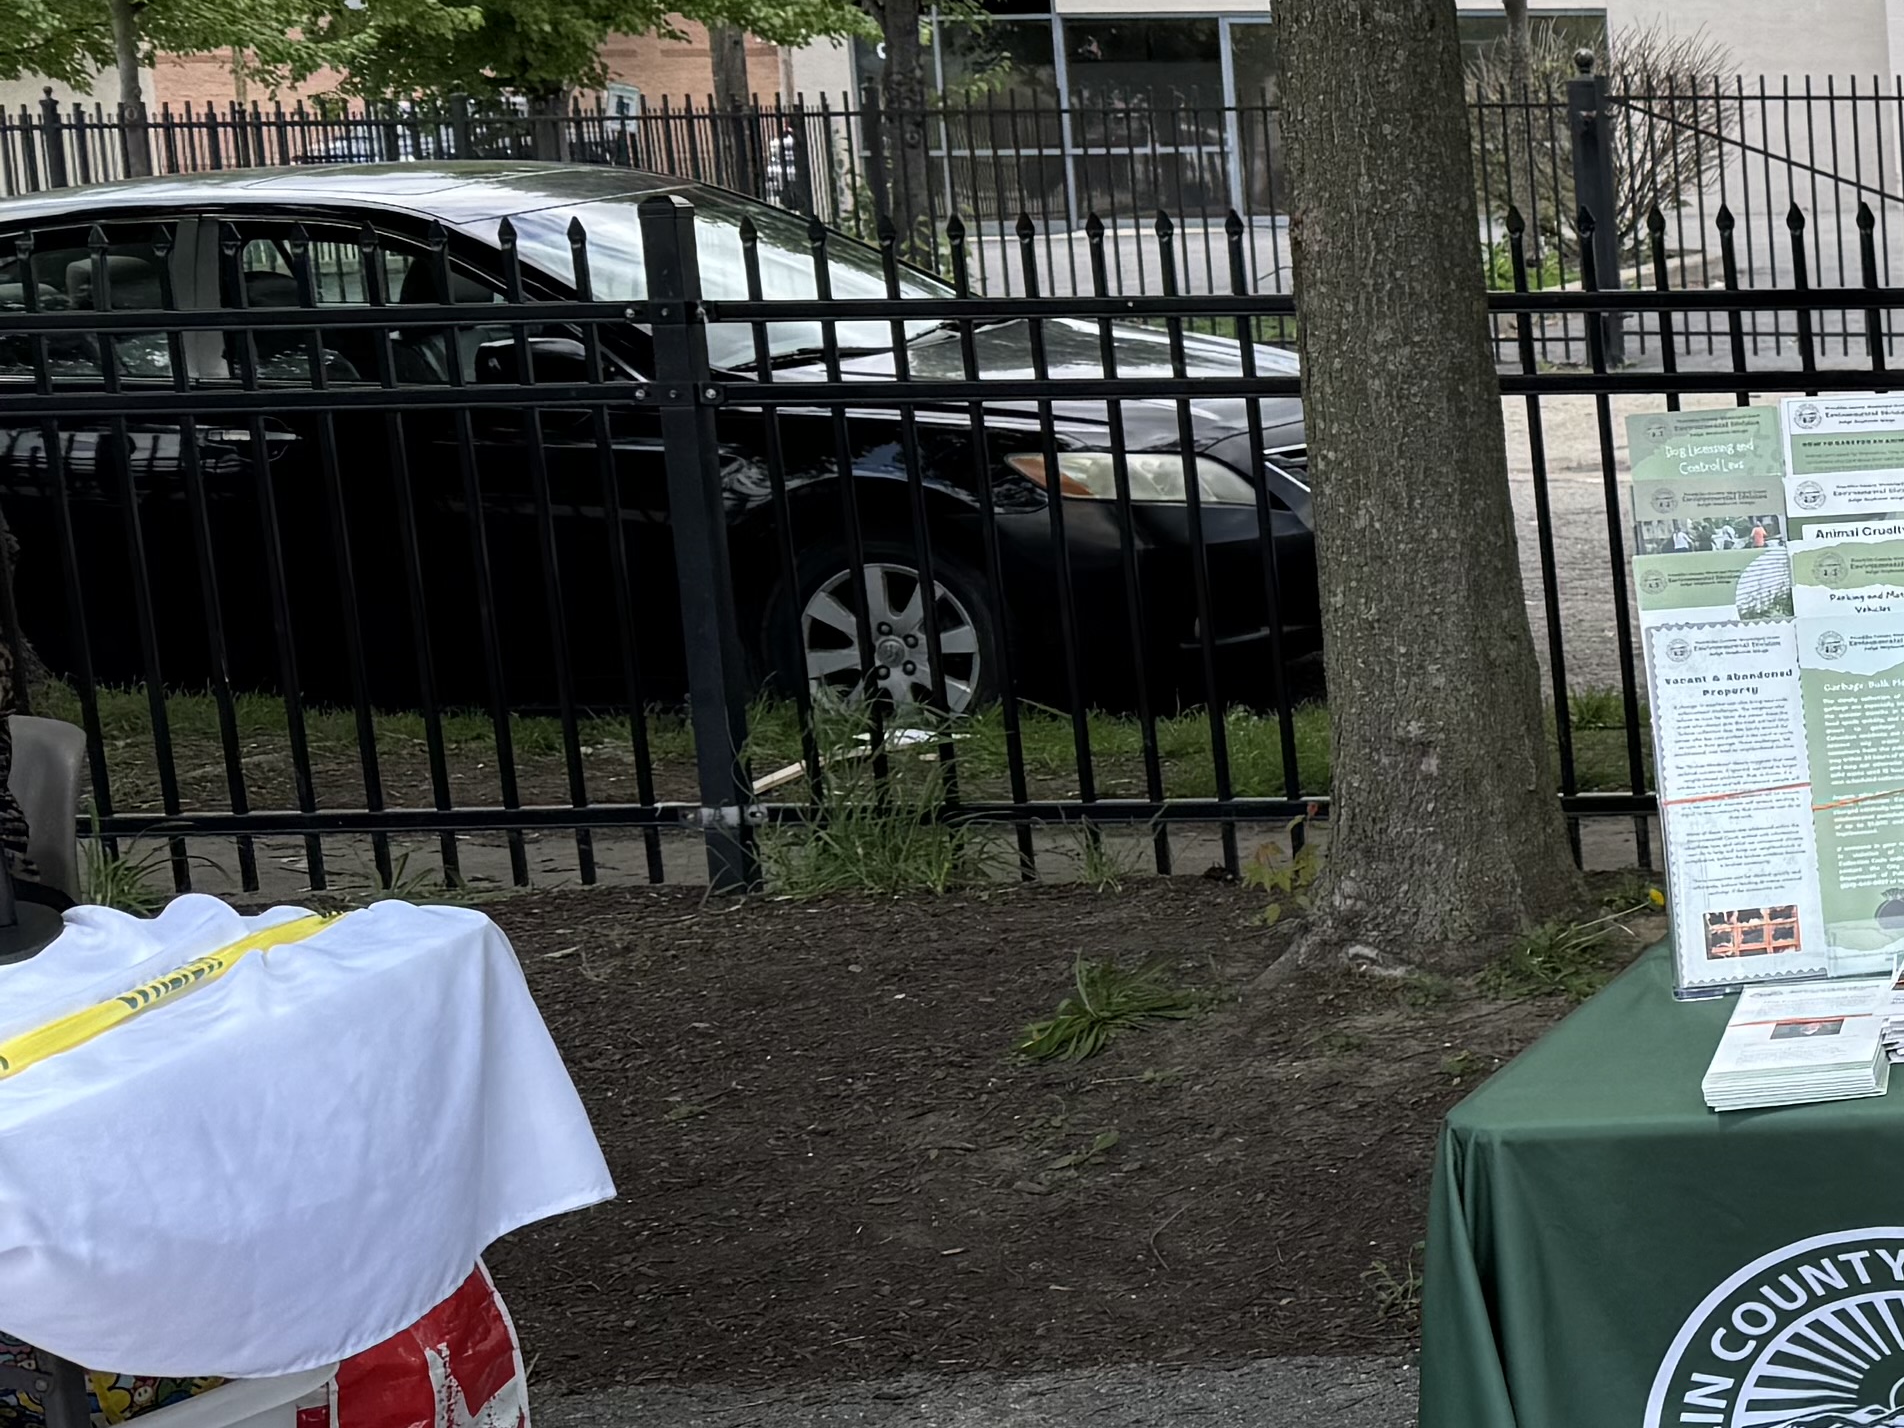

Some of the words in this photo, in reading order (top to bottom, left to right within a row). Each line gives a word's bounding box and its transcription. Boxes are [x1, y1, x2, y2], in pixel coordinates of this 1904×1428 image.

[1665, 445, 1686, 458] Dog
[1815, 527, 1859, 539] Animal
[1726, 668, 1793, 681] Abandoned
